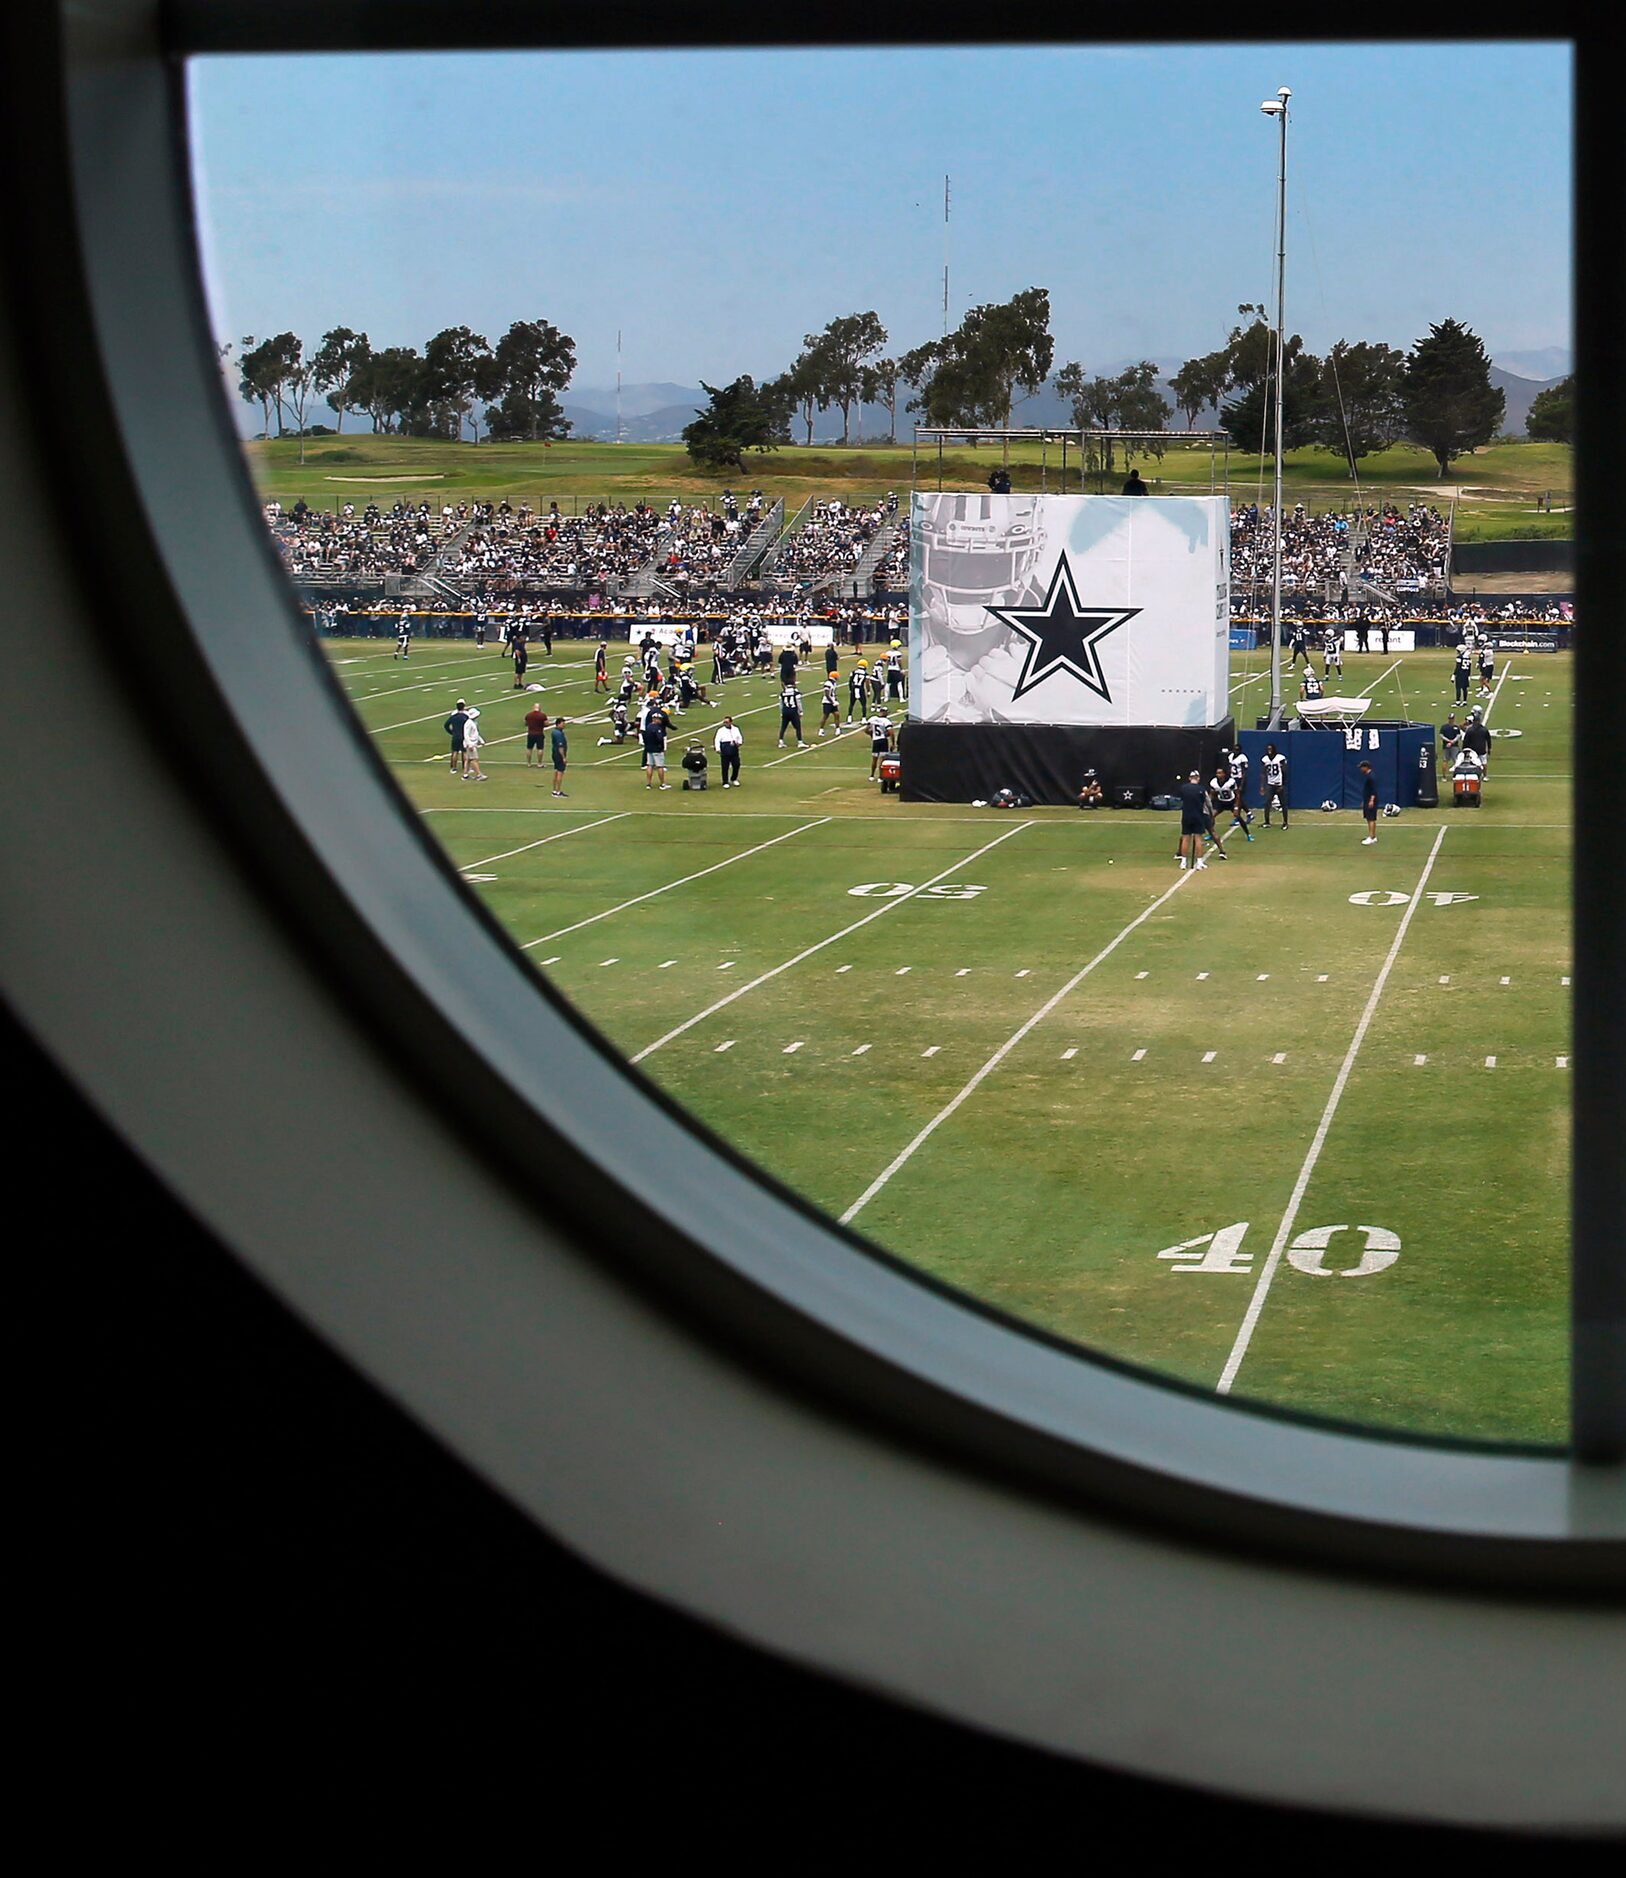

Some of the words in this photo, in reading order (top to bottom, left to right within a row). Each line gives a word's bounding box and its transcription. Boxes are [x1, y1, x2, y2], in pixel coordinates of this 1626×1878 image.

[1499, 640, 1555, 648] Blockchain.com
[853, 674, 865, 687] 47
[1307, 682, 1319, 694] 52
[847, 882, 989, 899] 50
[1348, 890, 1480, 906] 40
[1156, 1221, 1402, 1277] 40
